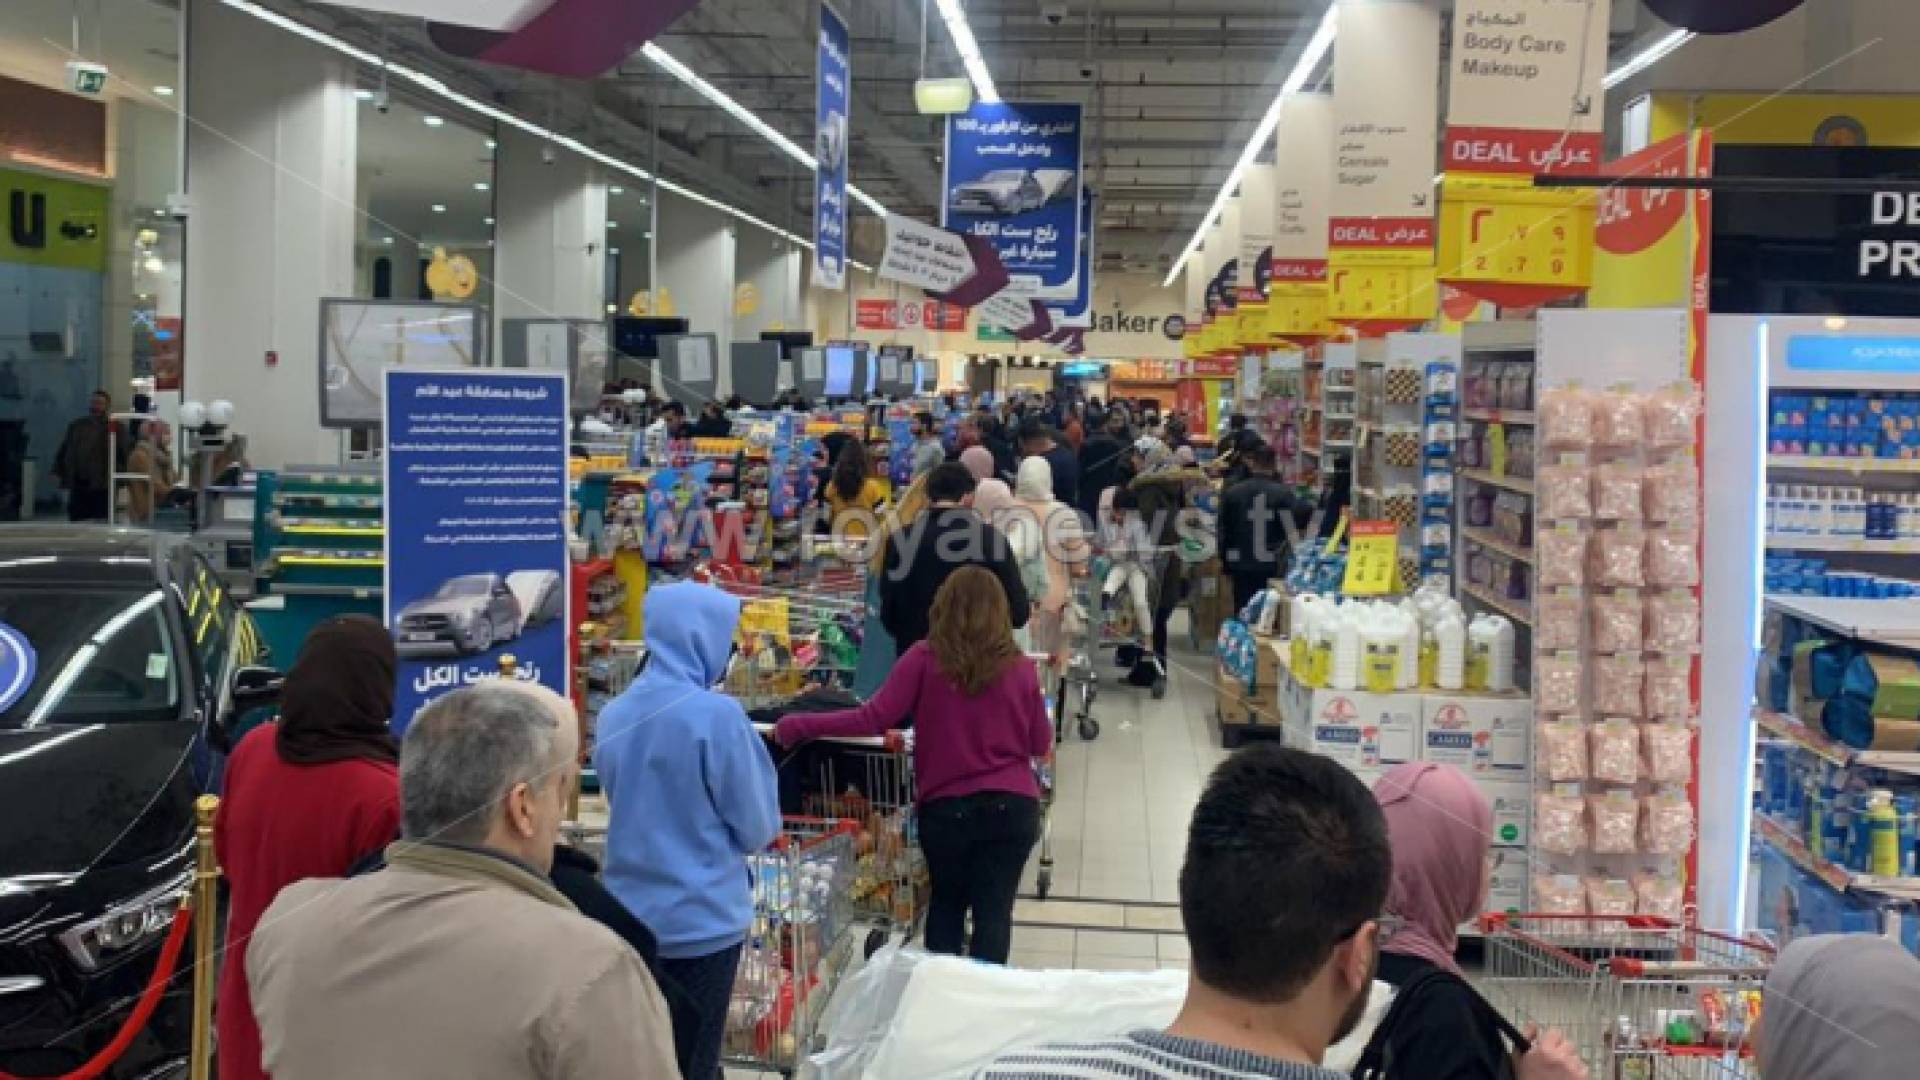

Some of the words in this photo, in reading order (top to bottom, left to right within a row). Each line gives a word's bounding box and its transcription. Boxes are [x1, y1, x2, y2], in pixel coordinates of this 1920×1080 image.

[1463, 31, 1513, 56] Body
[1519, 34, 1567, 54] Care
[1461, 59, 1540, 79] Makeup
[1452, 140, 1520, 163] DEAL
[1529, 143, 1592, 171] عرض
[1334, 226, 1380, 241] DEAL
[1384, 226, 1428, 244] عرض
[413, 664, 460, 692] الكل
